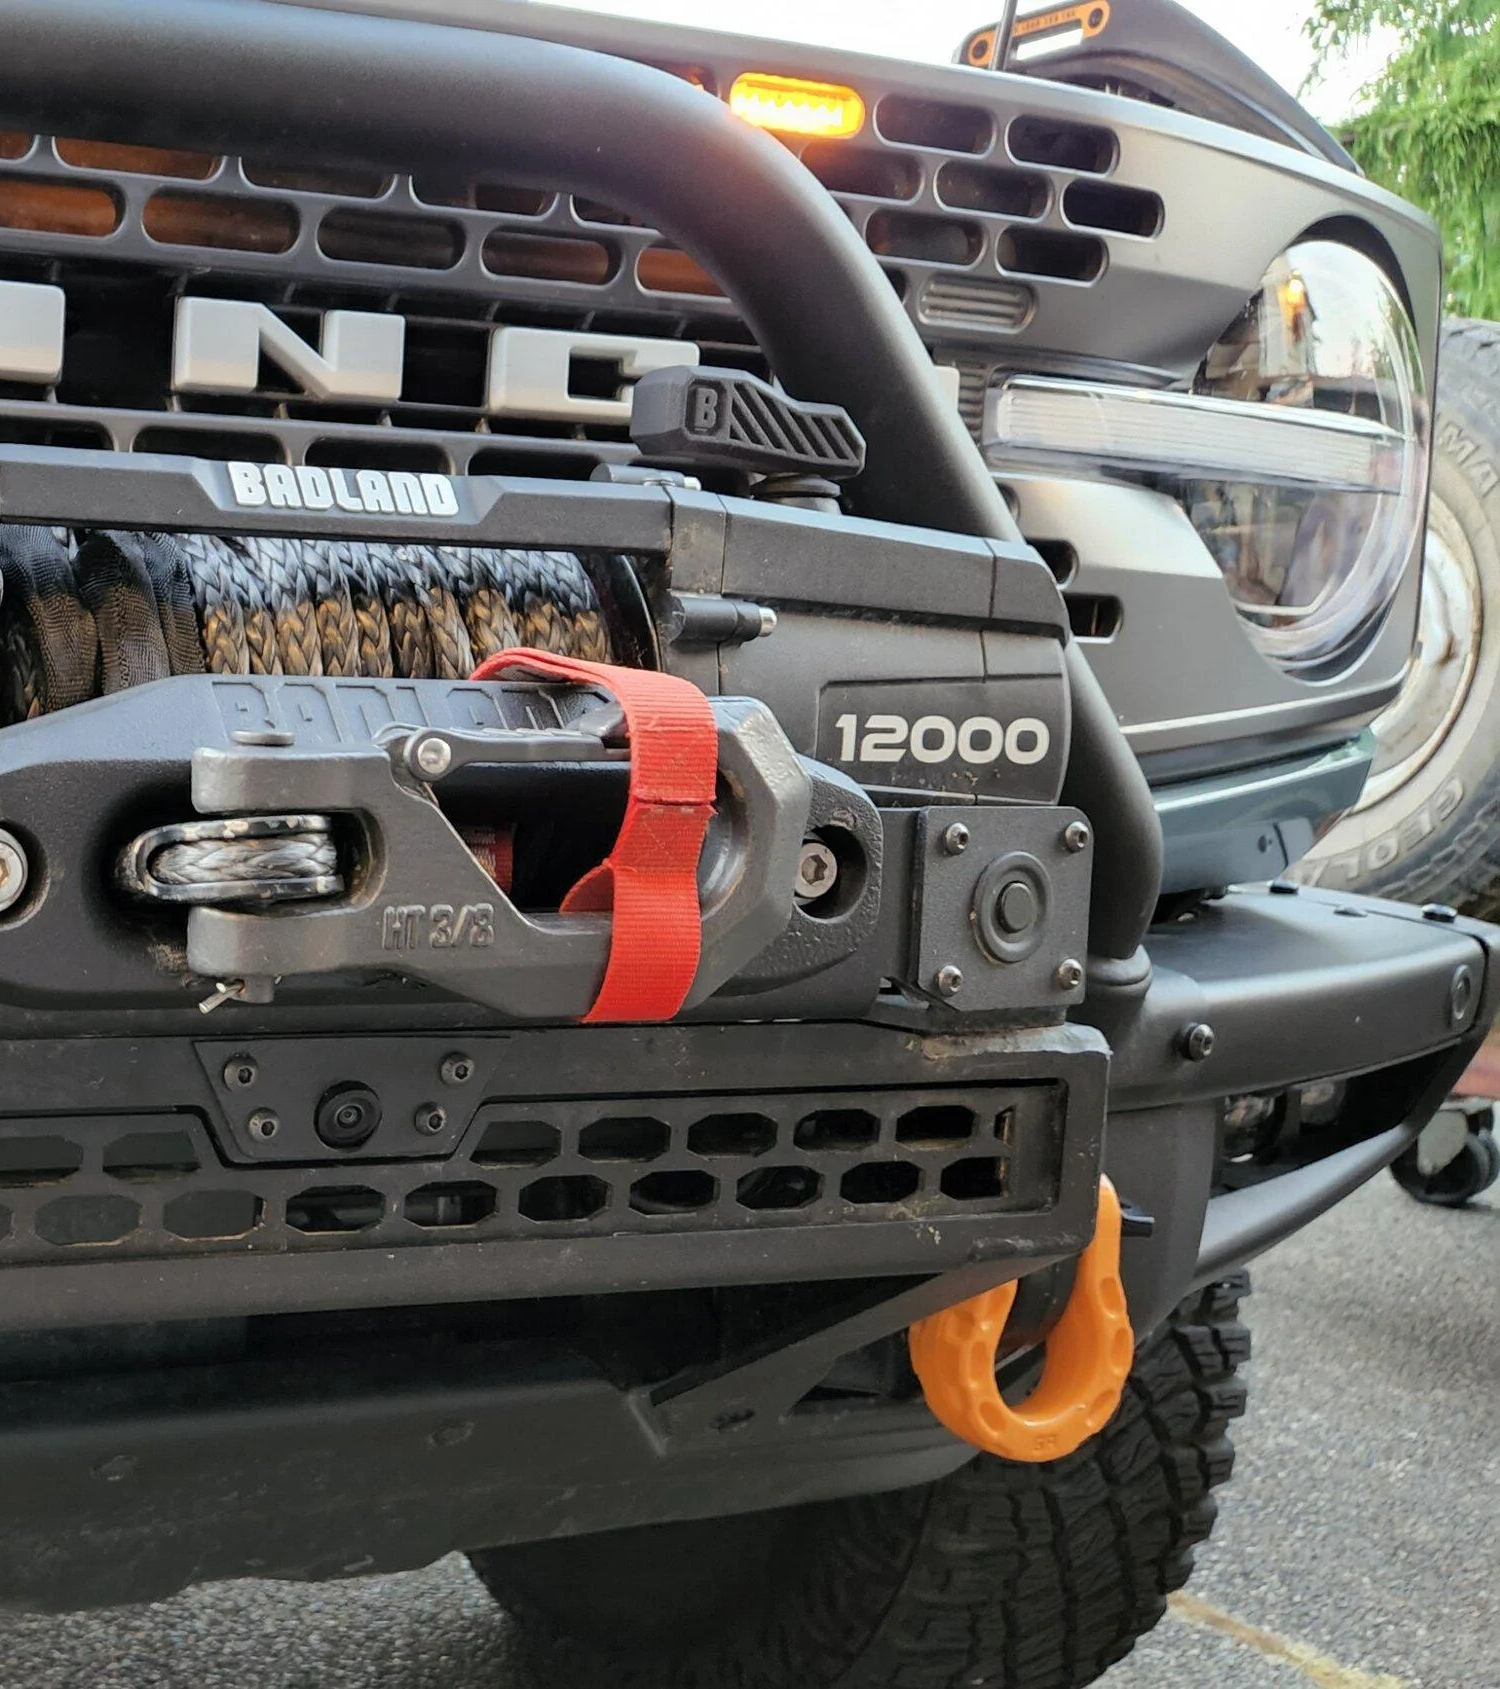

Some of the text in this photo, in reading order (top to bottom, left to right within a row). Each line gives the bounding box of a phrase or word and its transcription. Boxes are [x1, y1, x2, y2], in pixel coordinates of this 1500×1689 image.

[228, 461, 459, 517] BADLAND
[835, 714, 1049, 765] 12000
[382, 902, 494, 950] HT 3/8
